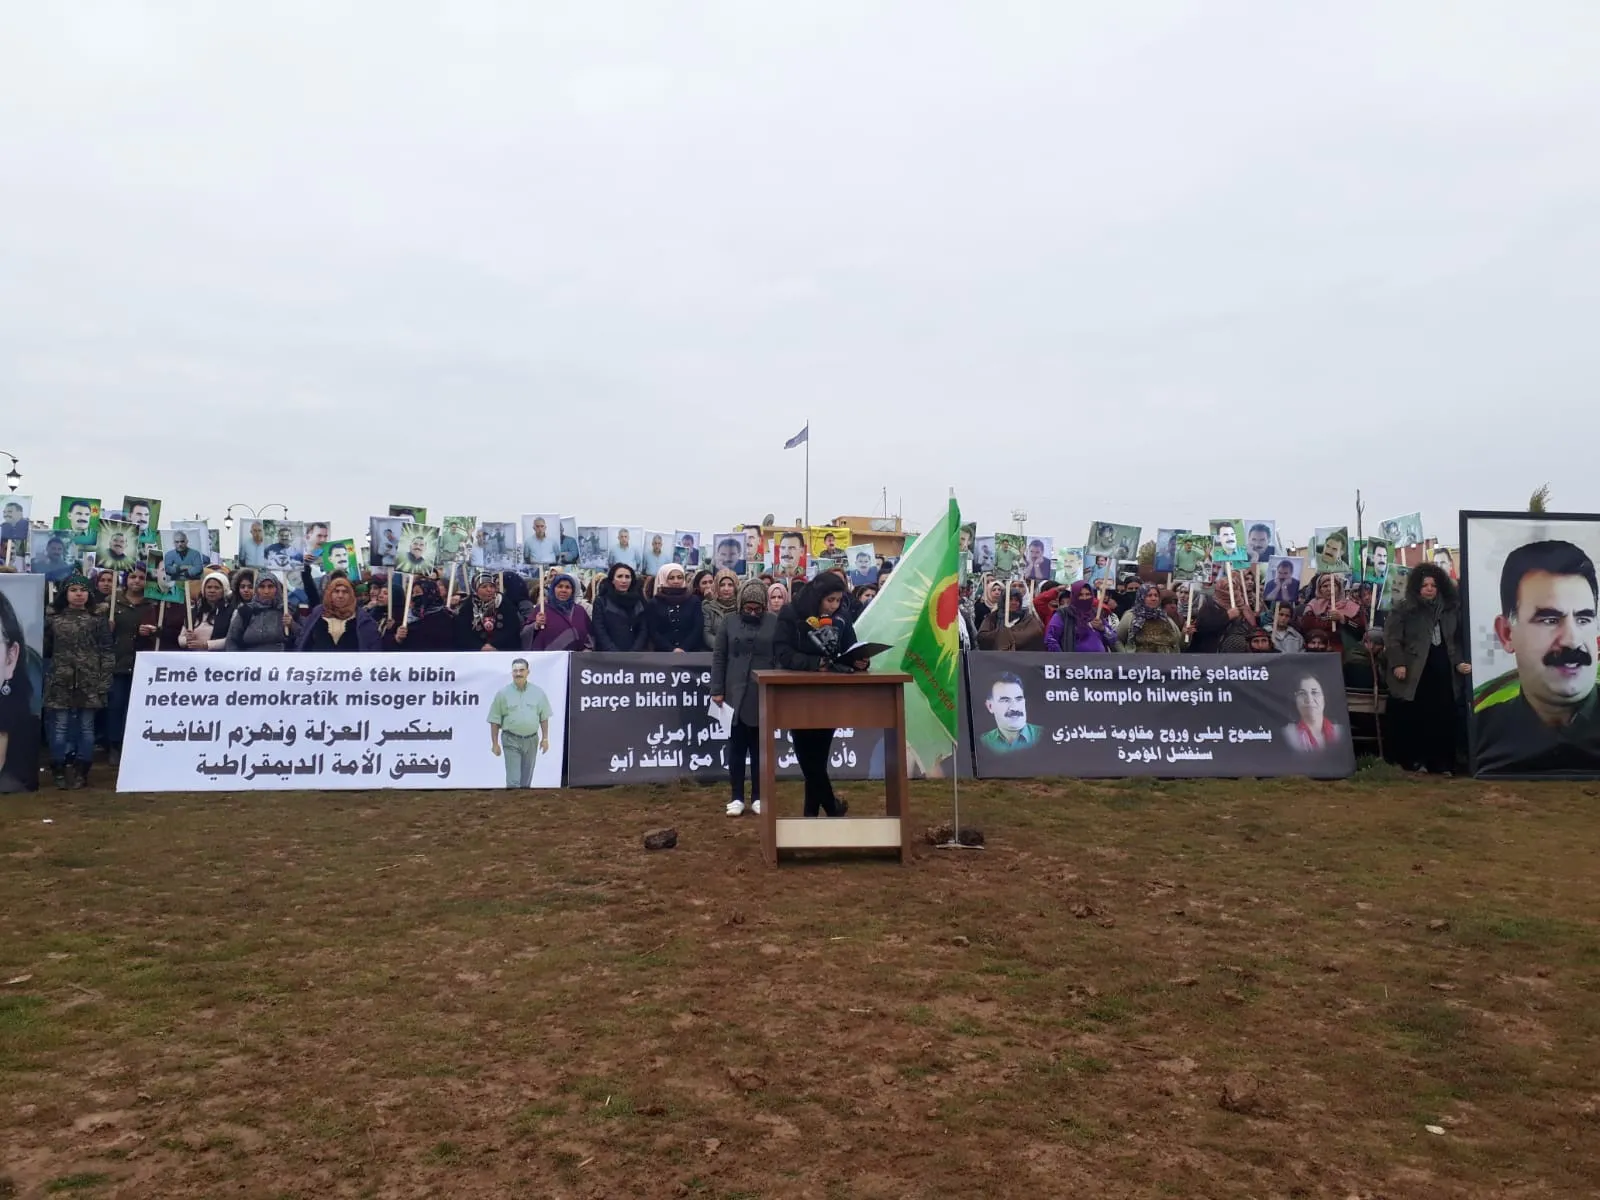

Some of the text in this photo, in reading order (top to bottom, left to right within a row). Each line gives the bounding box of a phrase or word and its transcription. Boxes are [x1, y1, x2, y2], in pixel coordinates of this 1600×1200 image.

[205, 667, 261, 682] tecrîd
[269, 668, 279, 681] û
[287, 667, 362, 685] faşîzmê
[370, 667, 401, 682] têk
[408, 667, 455, 682] bibin
[581, 669, 634, 684] Sonda
[641, 672, 665, 683] me
[672, 672, 690, 687] ye
[1044, 664, 1061, 680] Bi
[1065, 665, 1113, 680] sekna
[1117, 665, 1166, 684] Leyla,
[1170, 665, 1202, 680] rihê
[145, 690, 479, 709] netewa demokratîk misoger bikin
[581, 696, 630, 711] parçe
[636, 692, 676, 706] bikin
[683, 692, 697, 706] bi
[1045, 687, 1233, 706] emê komplo hilweşîn in
[142, 719, 452, 748] سنكسر العزلة ونهزم الفاشية
[647, 724, 691, 748] إمرلي
[1111, 725, 1154, 743] مقاومة
[1159, 728, 1190, 743] وروح
[1193, 725, 1224, 743] ليلى
[1228, 725, 1273, 743] بشموخ
[196, 748, 450, 780] ونحقق الأمة الديمقراطية
[609, 748, 633, 772] آبو
[690, 754, 712, 770] مع
[831, 742, 856, 767] وأن
[1166, 746, 1213, 763] سنفشل
